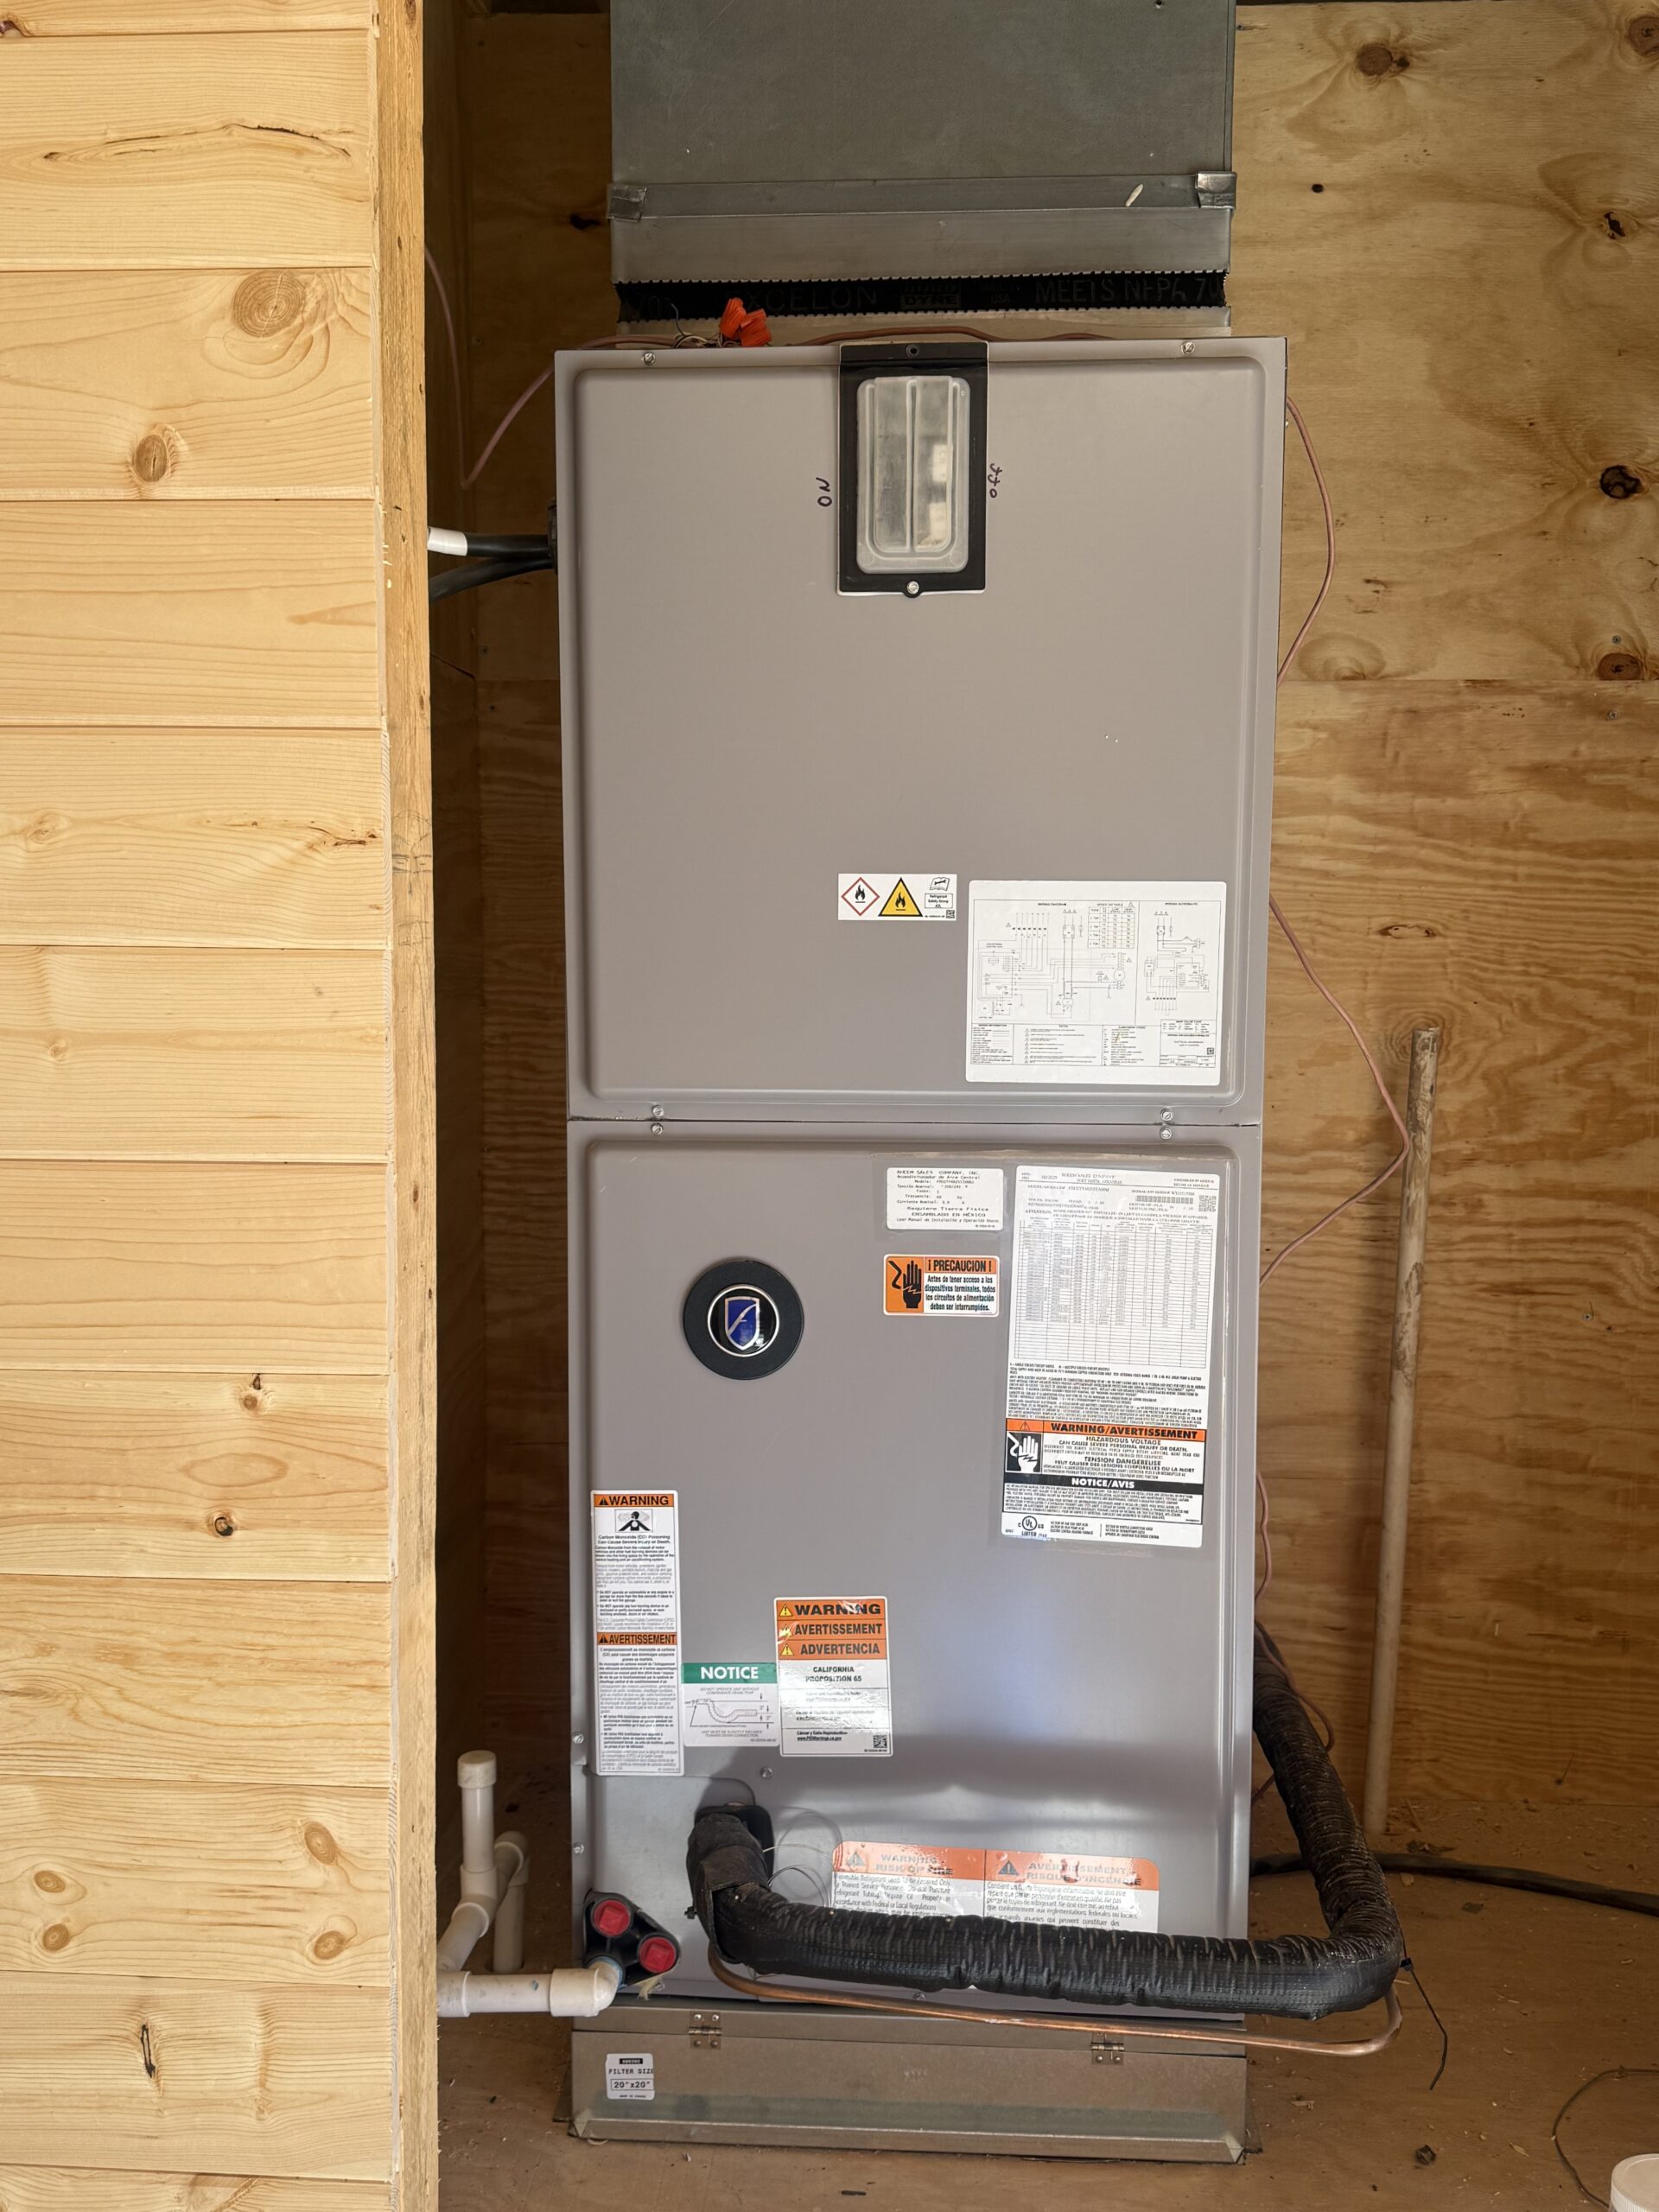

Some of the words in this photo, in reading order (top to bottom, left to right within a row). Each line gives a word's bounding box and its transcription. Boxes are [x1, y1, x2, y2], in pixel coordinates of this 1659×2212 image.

[1036, 279, 1115, 303] MEETS
[724, 286, 878, 312] XCELON
[816, 477, 832, 506] ON
[933, 1259, 985, 1272] PRECAUCION
[1052, 1423, 1198, 1439] WARNING/AVERTISSEMENT
[1071, 1478, 1135, 1489] NOTICE/AVIS
[609, 1496, 668, 1505] WARNING
[795, 1604, 880, 1615] WARNNG
[795, 1624, 882, 1635] AVERTISSEMENT
[610, 1635, 676, 1643] AVERTISSEMENT
[801, 1643, 880, 1655] ADVERTENCIA
[701, 1667, 759, 1680] NOTICE
